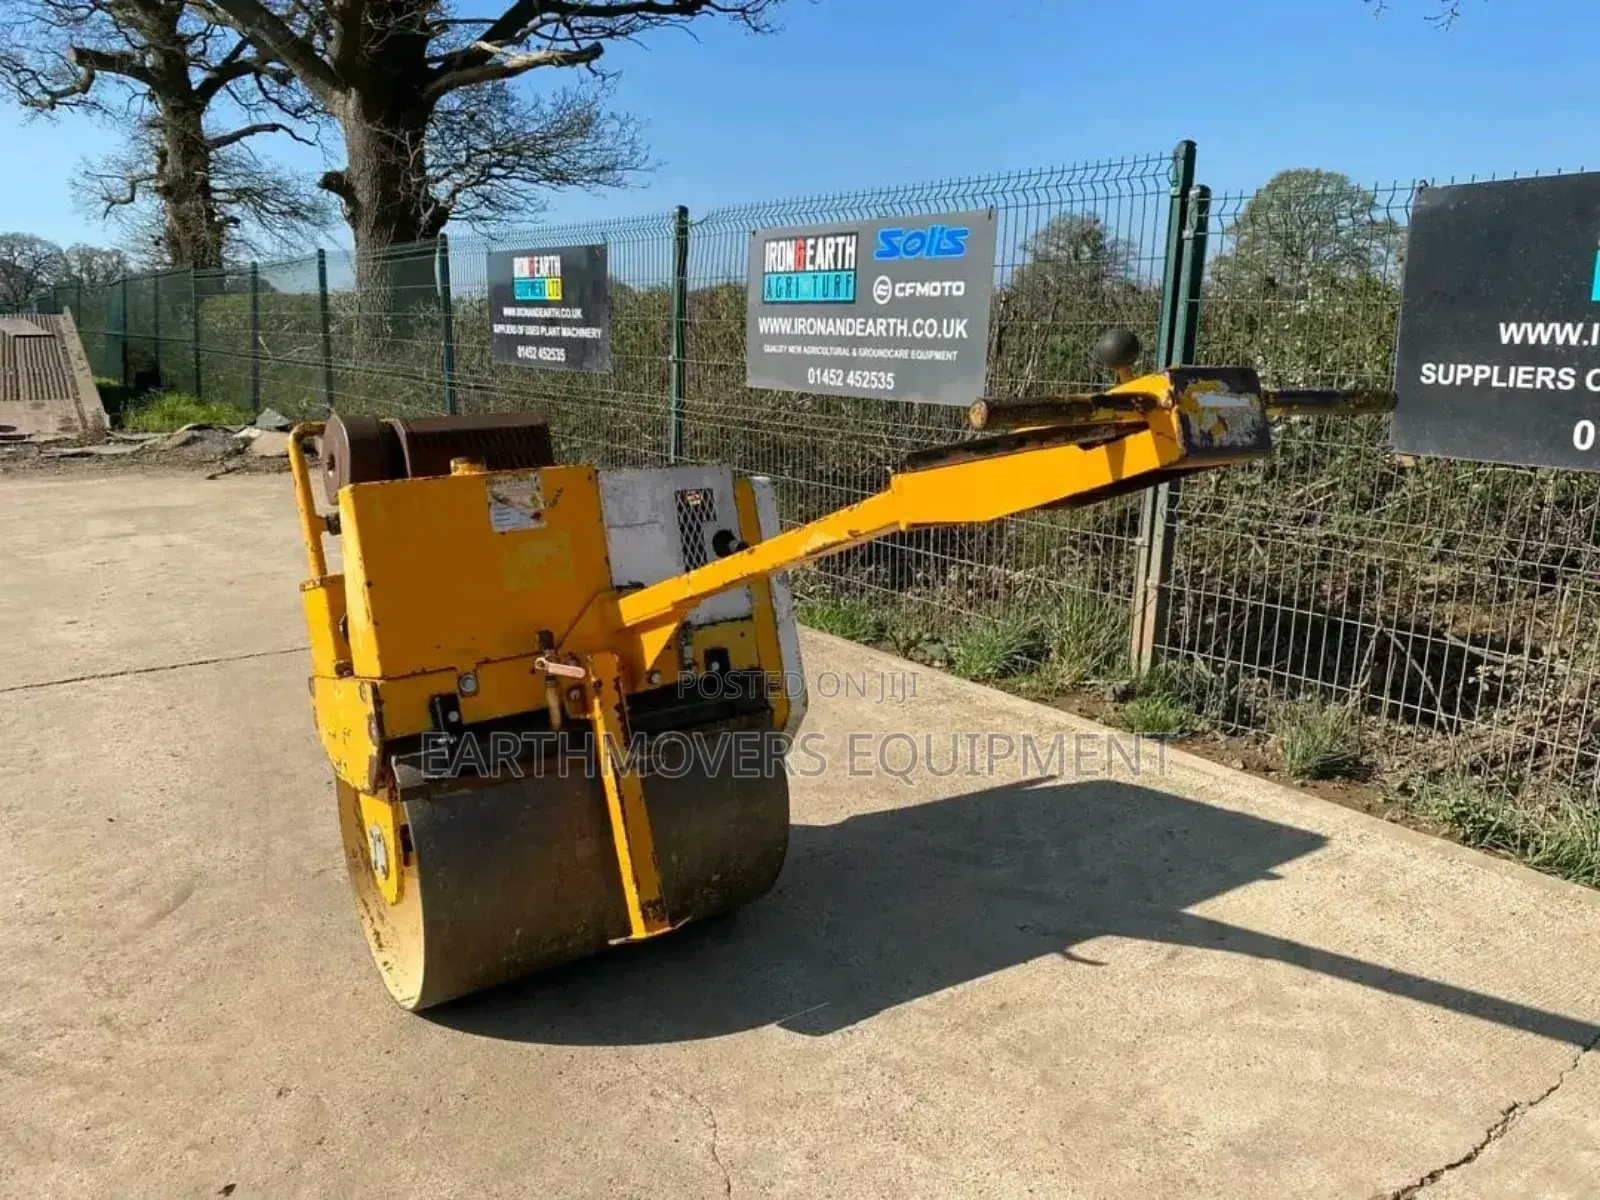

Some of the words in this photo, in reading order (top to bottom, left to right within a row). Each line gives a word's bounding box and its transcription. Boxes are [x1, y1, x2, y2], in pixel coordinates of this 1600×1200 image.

[765, 276, 800, 298] AGRI
[812, 273, 852, 298] TURF
[895, 281, 965, 297] CFMOTO
[758, 317, 969, 339] WWW.IRONANDEARTH.CO.UK
[911, 349, 958, 362] EQUIPMENT
[807, 367, 844, 386] 01452
[846, 371, 896, 390] 452535
[1420, 362, 1576, 391] SUPPLIERS
